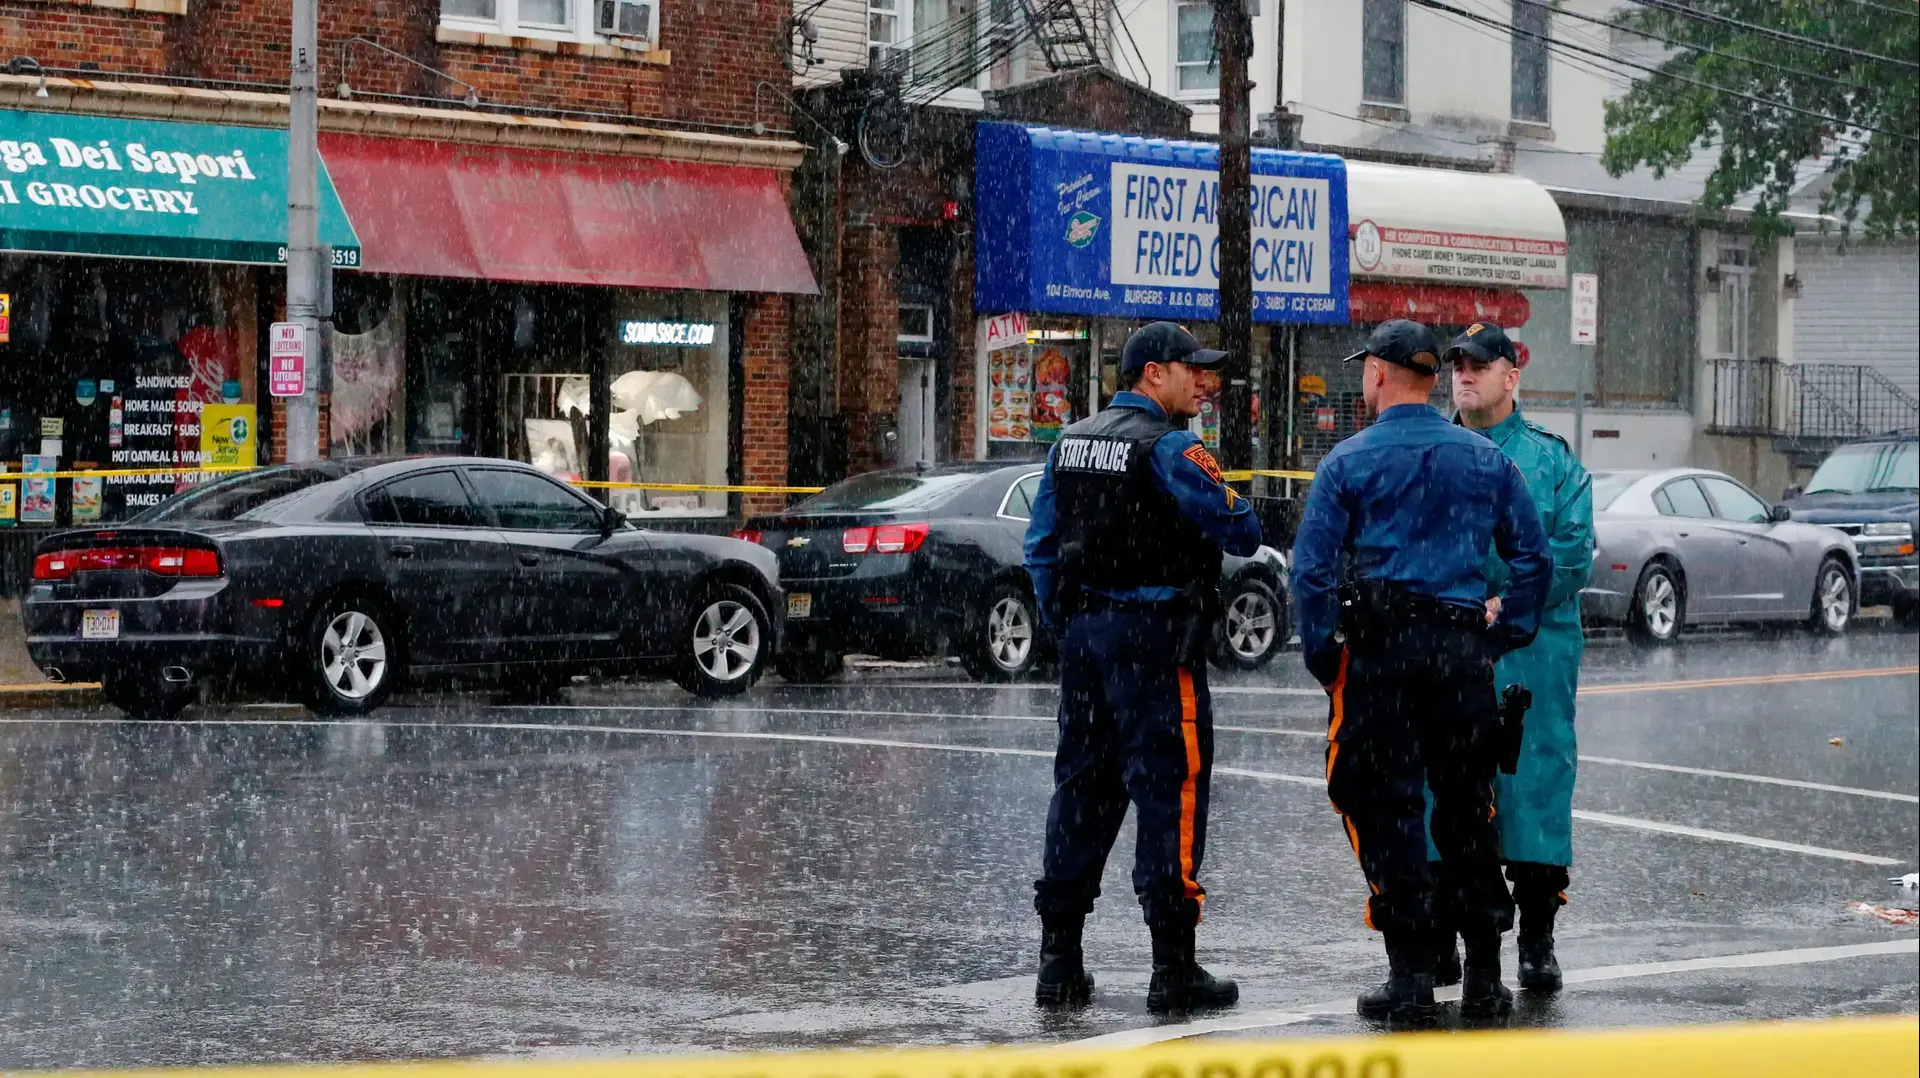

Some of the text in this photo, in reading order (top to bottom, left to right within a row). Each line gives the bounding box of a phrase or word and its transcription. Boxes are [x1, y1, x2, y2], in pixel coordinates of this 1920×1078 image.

[0, 138, 256, 184] ga Dei Sapori
[27, 182, 198, 215] GROCERY
[1124, 174, 1316, 231] FIRST AMRICAN
[1398, 231, 1441, 246] COMPUTER
[1135, 230, 1202, 277] FRIED
[1210, 234, 1314, 284] CCKEN
[1392, 247, 1412, 259] PHONE
[1413, 249, 1433, 260] CARDS
[1434, 250, 1454, 262] MONEY
[1456, 252, 1488, 265] TRANSFERS
[1490, 255, 1502, 266] BILL
[1503, 256, 1527, 268] PAYMENT
[1427, 264, 1455, 276] INTERNET
[1463, 267, 1493, 278] COMPUTER
[1495, 269, 1521, 280] SERVICES
[1046, 284, 1060, 297] 104
[1062, 285, 1092, 299] Elmora
[1124, 288, 1163, 305] BURGERS
[1196, 292, 1214, 307] RIBS
[1265, 296, 1286, 310] SUBS
[1291, 297, 1306, 311] ICE
[1307, 298, 1336, 312] CREAM
[282, 328, 295, 339] NO
[988, 311, 1026, 341] ATM
[281, 359, 294, 370] NO
[136, 376, 190, 388] SANDWICHES
[125, 400, 204, 413] HOME MADE SOUPS
[124, 424, 200, 436] BREAKFAST SUBS
[212, 435, 228, 444] New
[112, 451, 212, 463] HOT OATMEAL & WRAPS
[1058, 438, 1131, 472] STATE POLICE
[106, 473, 147, 485] NATURAL
[148, 472, 175, 484] JUICES
[181, 471, 198, 483] HOT
[126, 493, 159, 506] SHAKES
